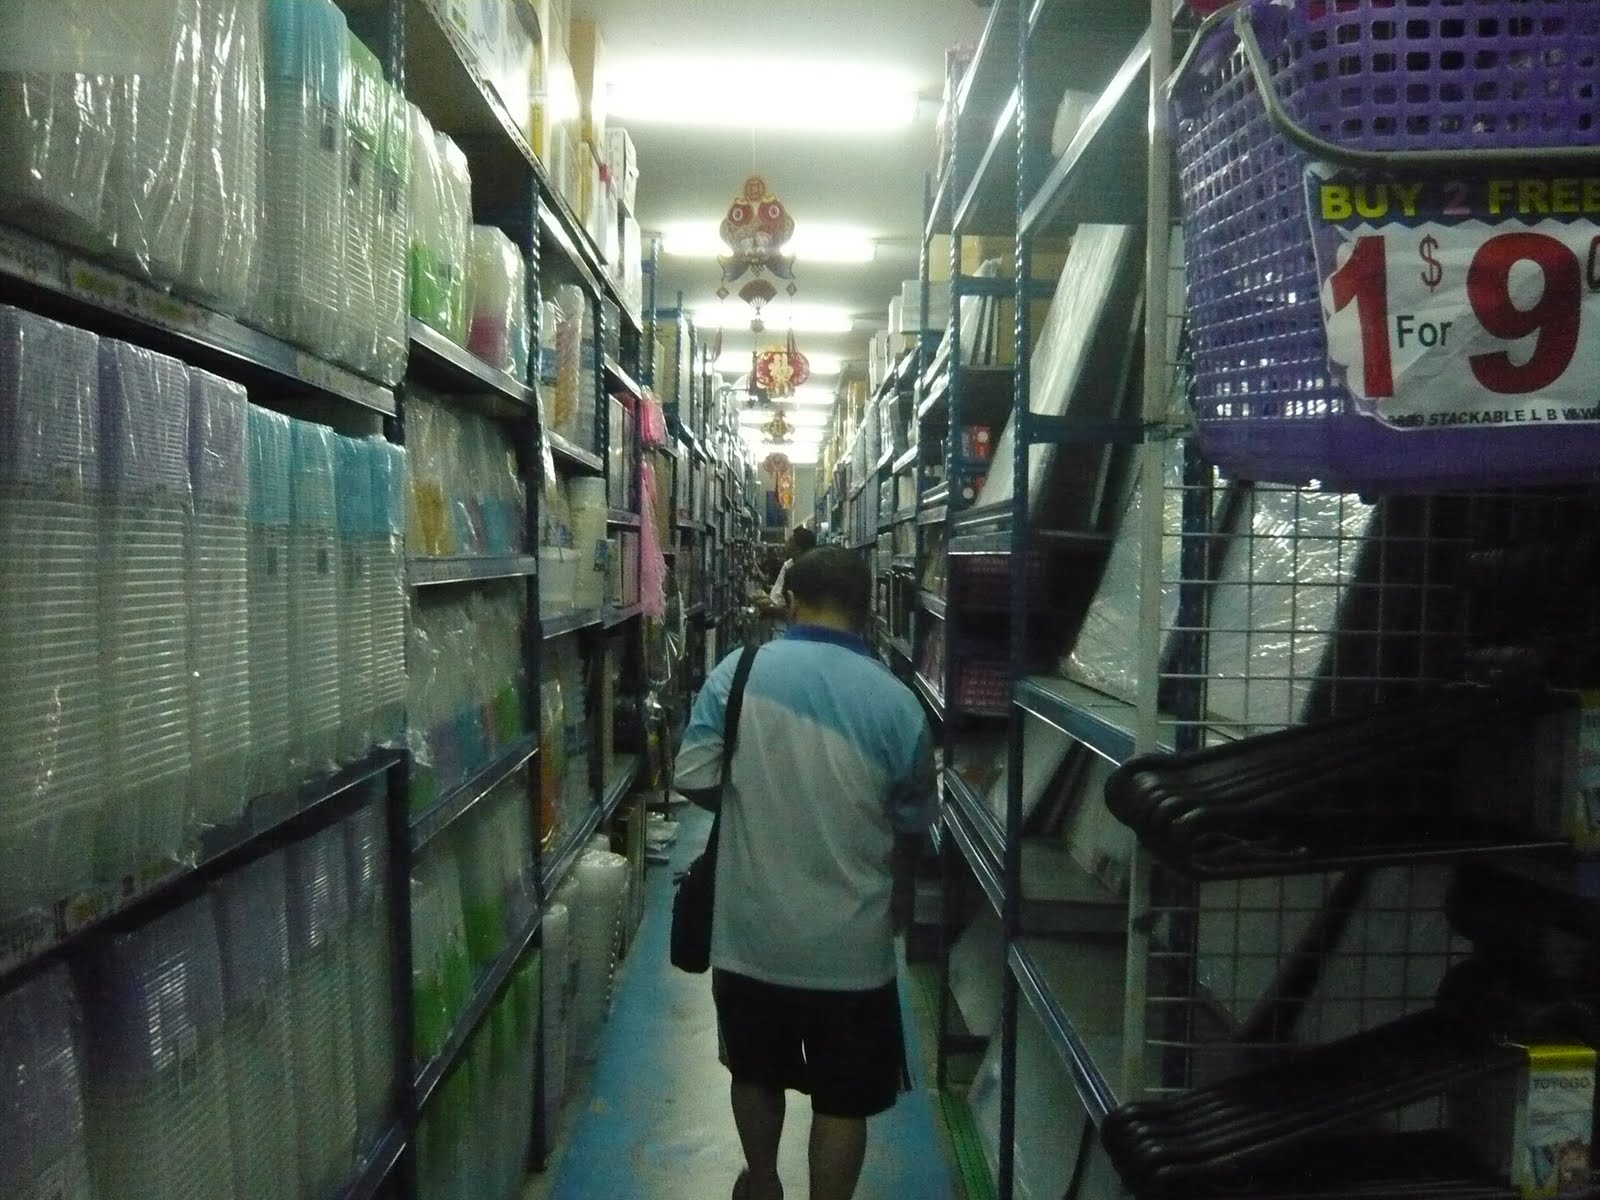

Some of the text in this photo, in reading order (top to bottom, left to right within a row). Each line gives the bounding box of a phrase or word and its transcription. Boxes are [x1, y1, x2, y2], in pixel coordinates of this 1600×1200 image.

[1320, 182, 1423, 220] BUY
[1442, 181, 1471, 216] 2
[1419, 234, 1443, 293] $
[1331, 235, 1393, 398] 1
[1396, 314, 1453, 349] For
[1466, 232, 1582, 394] 9
[1427, 408, 1526, 426] STACKABLE
